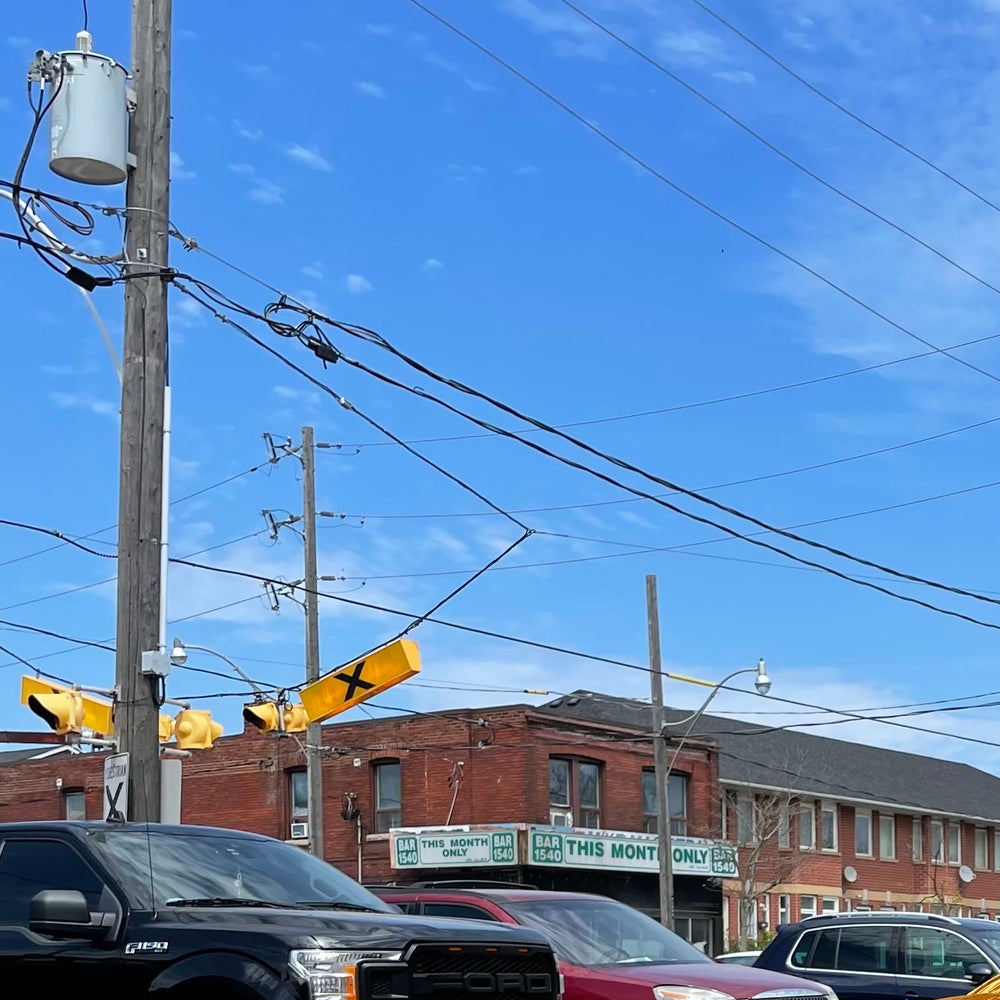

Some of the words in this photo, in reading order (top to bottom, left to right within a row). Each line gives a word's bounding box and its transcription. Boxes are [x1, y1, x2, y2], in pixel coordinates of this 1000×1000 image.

[399, 839, 416, 850] BAR
[421, 839, 444, 849] THIS
[451, 838, 488, 848] MONTH
[493, 835, 512, 847] BAR
[535, 835, 560, 848] BAR
[398, 851, 418, 864] 1540
[442, 848, 468, 857] ONLY
[493, 847, 513, 860] 1540
[534, 850, 562, 862] 1540
[567, 839, 604, 857] THIS
[611, 843, 661, 861] MONT
[673, 848, 708, 864] ONLY
[713, 861, 736, 873] 1540
